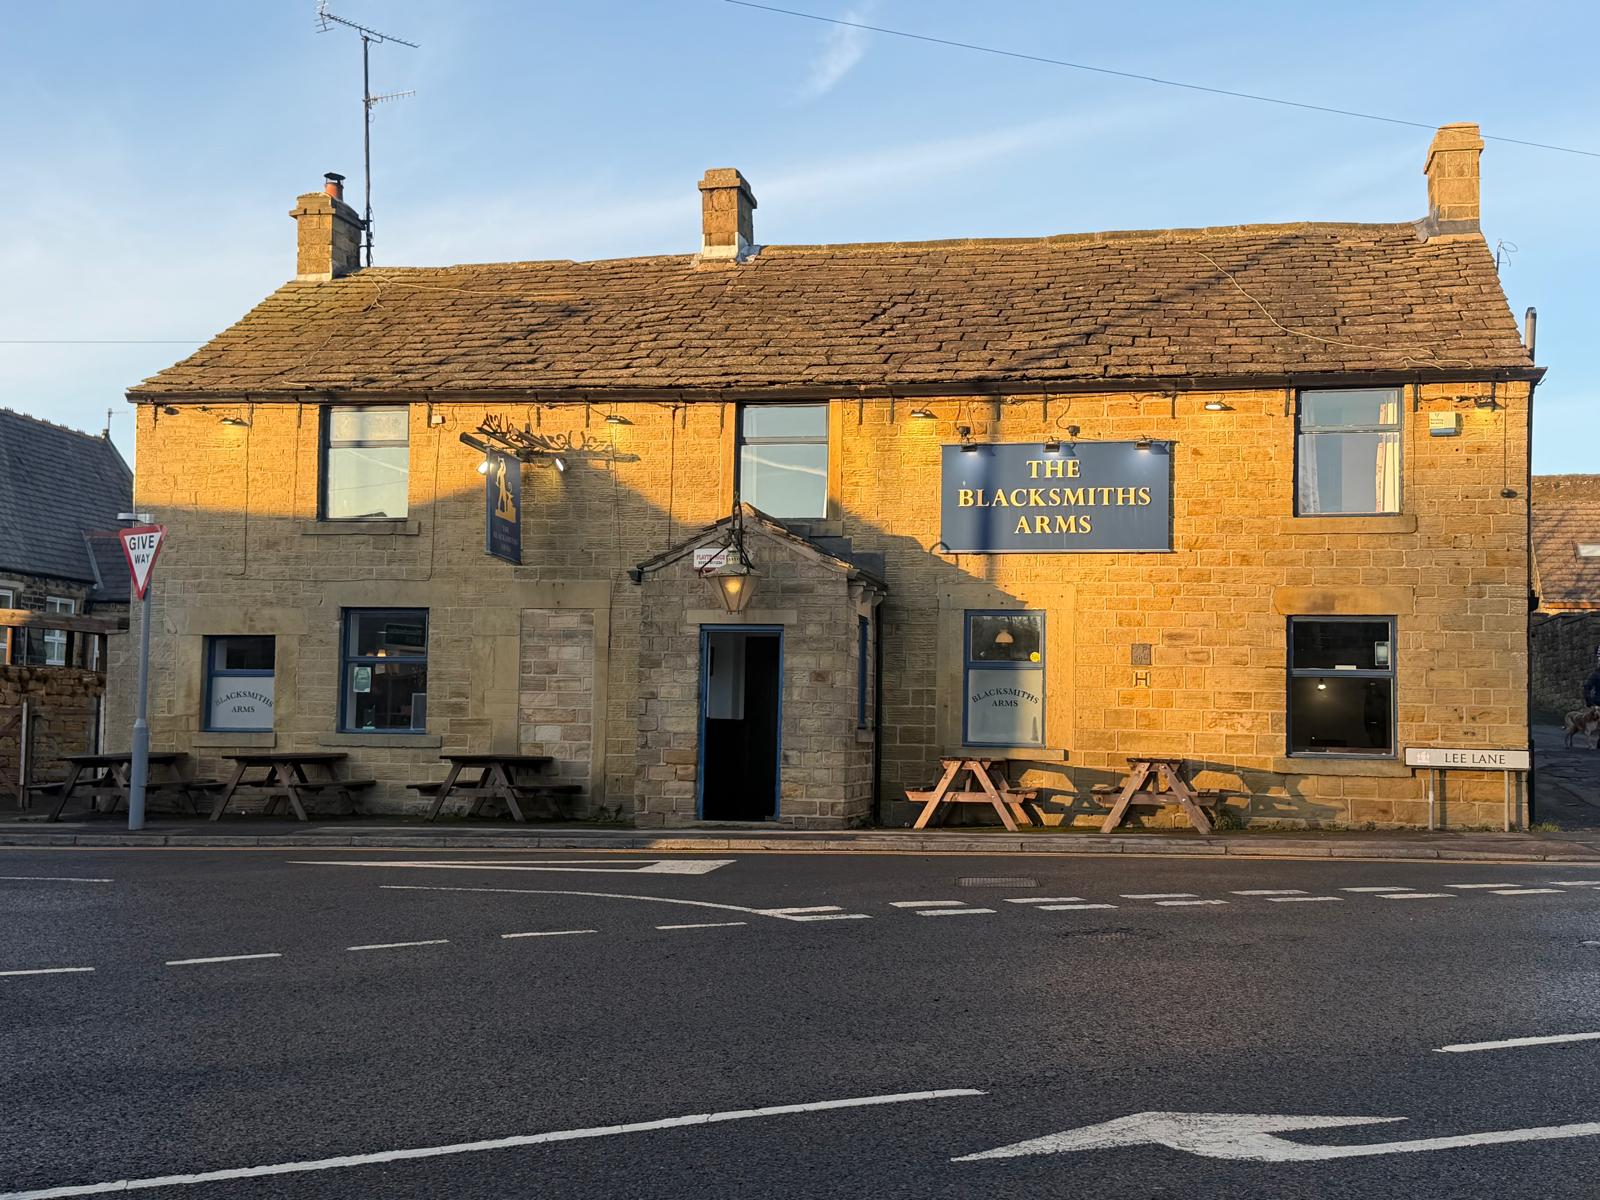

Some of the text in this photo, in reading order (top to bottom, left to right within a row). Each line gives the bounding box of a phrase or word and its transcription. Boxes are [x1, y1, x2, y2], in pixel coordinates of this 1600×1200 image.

[1026, 459, 1081, 479] THE
[958, 487, 1152, 507] BLACKSMITHS
[1014, 515, 1092, 534] ARMS
[129, 535, 155, 550] GIVE
[135, 553, 150, 564] WAY
[971, 687, 1040, 705] BLACKSMITHS
[231, 705, 255, 713] ARMS
[1445, 753, 1506, 764] LEE LANE
